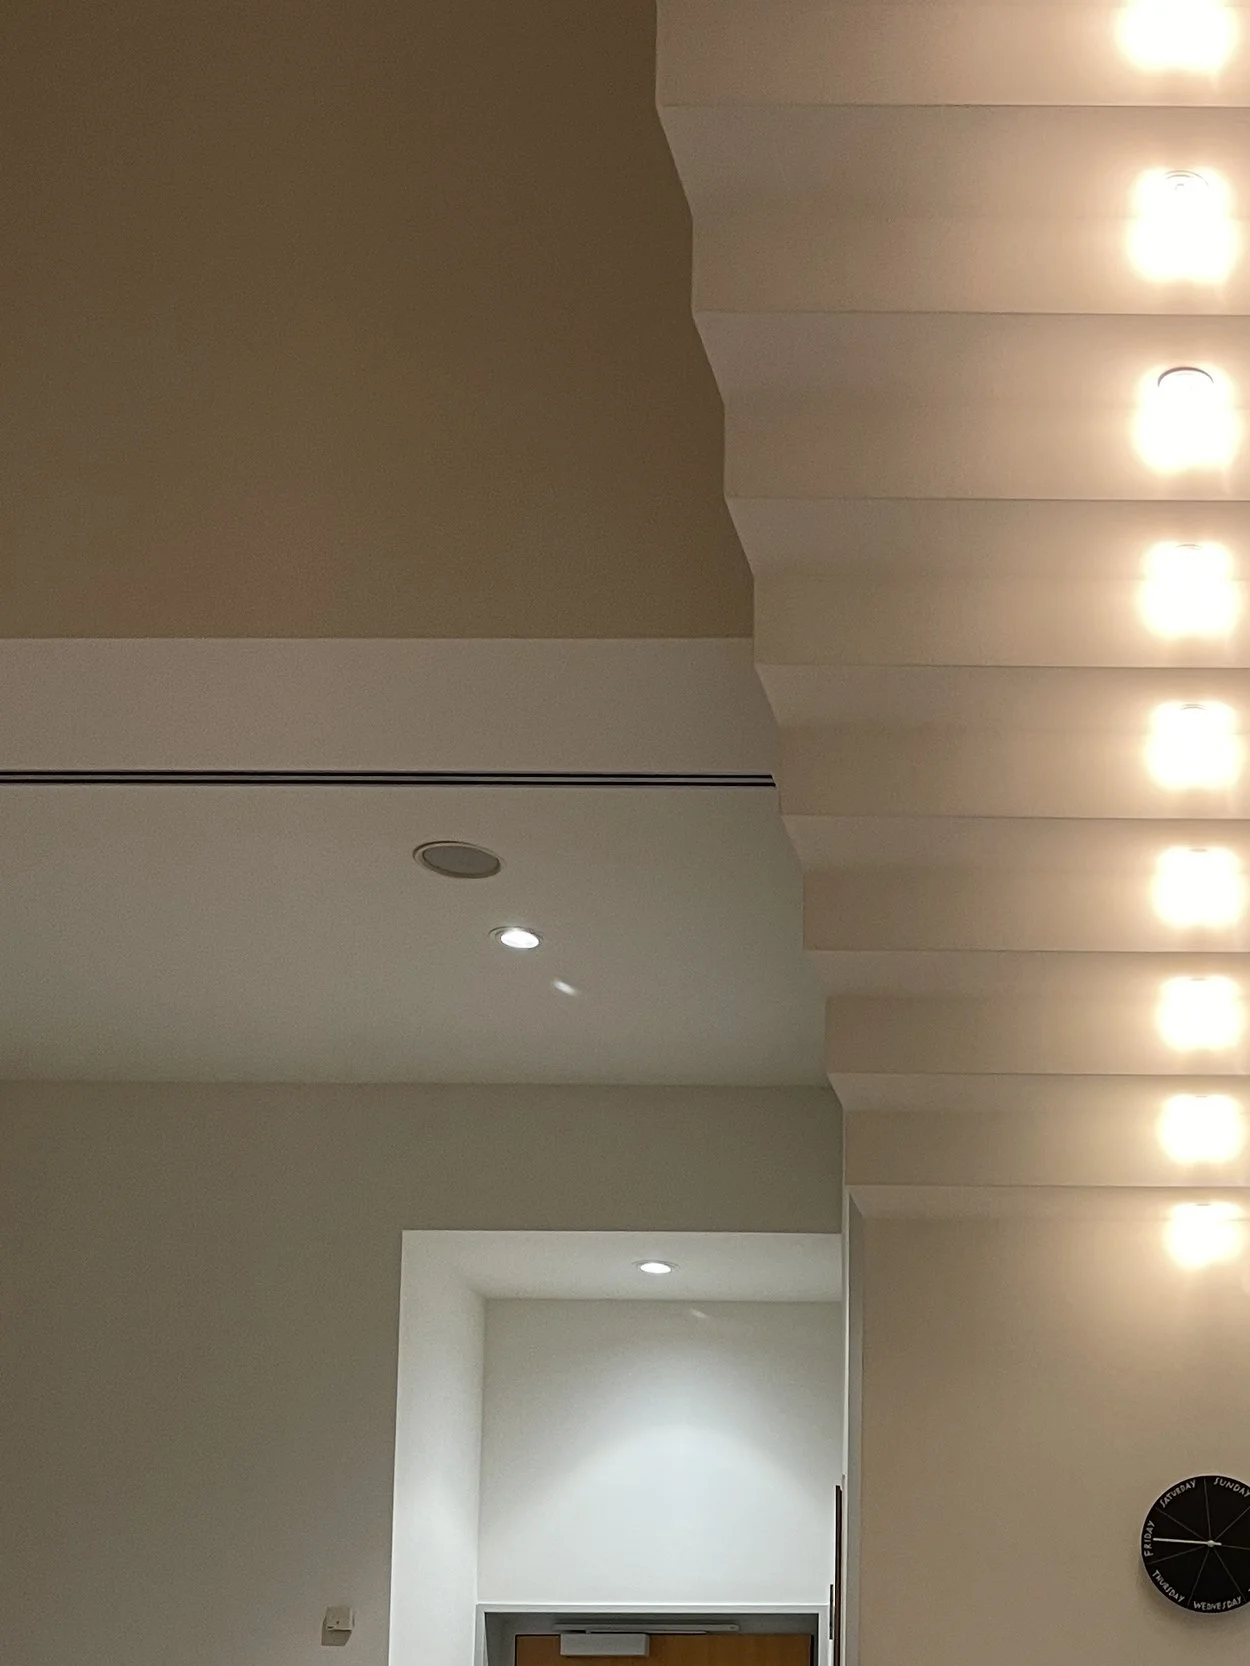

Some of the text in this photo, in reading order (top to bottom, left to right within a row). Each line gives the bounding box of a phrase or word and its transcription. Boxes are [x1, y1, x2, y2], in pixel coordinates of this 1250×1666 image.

[1160, 1480, 1197, 1508] SATURDAY
[1143, 1520, 1156, 1558] FRIDAY
[1152, 1569, 1186, 1603] THURSDAY
[1193, 1595, 1242, 1611] WEDNESDAY
